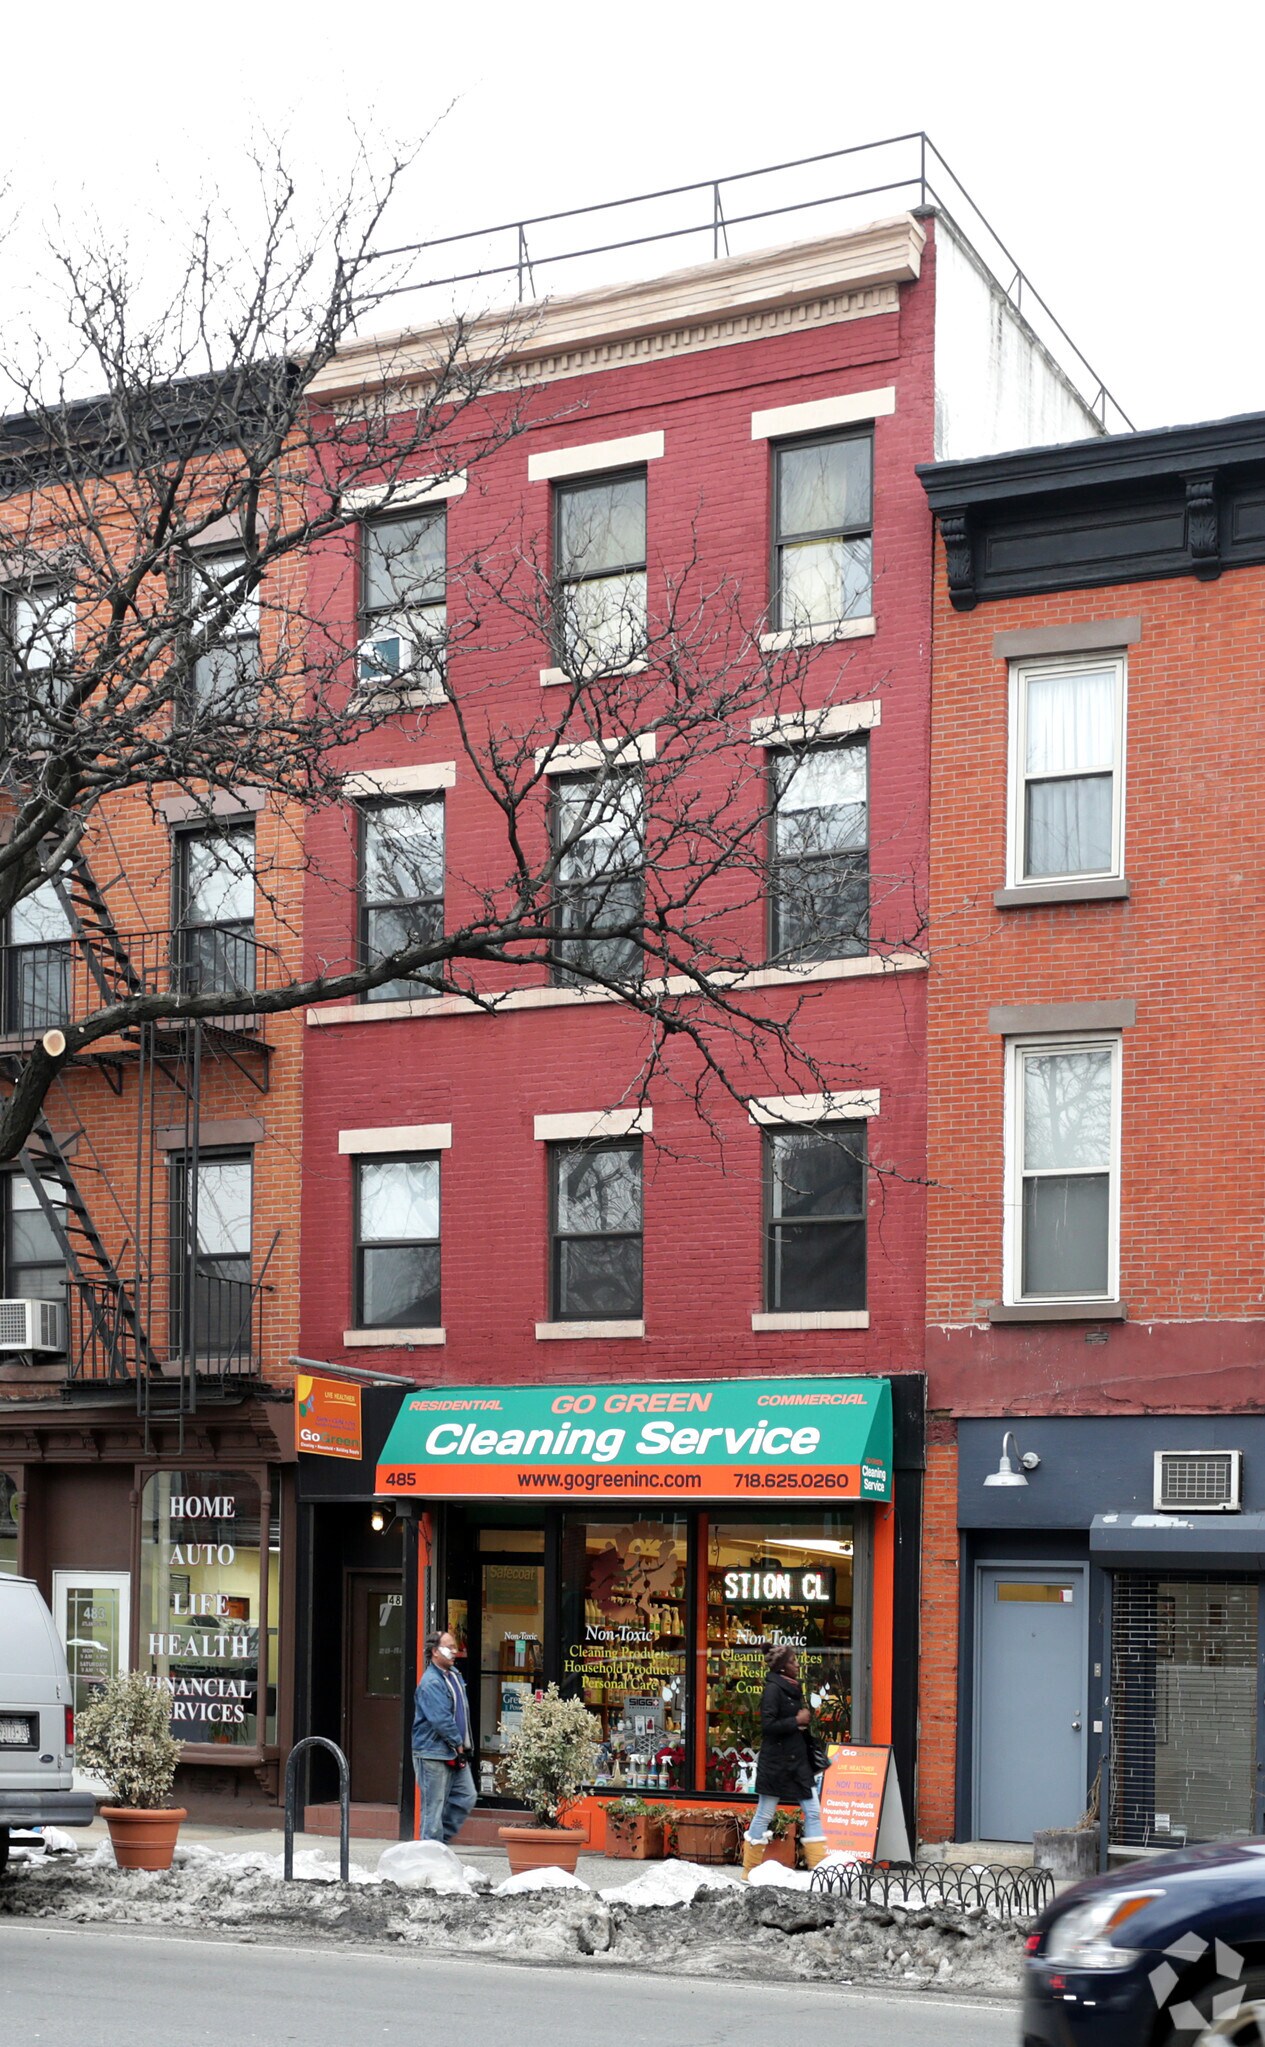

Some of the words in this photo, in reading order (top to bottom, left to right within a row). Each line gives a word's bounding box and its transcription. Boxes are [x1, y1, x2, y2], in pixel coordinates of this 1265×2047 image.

[324, 1391, 333, 1399] LIVE
[757, 1393, 868, 1406] COMMERCIAL
[409, 1400, 503, 1411] RESIDENTIAL
[551, 1394, 597, 1414] GO
[603, 1392, 713, 1414] GREEN
[425, 1421, 626, 1462] Cleaning
[635, 1419, 821, 1455] Service
[386, 1472, 416, 1486] 485
[517, 1471, 701, 1490] www.gogreeninc.com
[733, 1473, 849, 1488] 718.625.0260
[862, 1465, 886, 1482] Cleaning
[863, 1478, 885, 1492] Service
[169, 1496, 235, 1518] HOME
[169, 1543, 235, 1566] AUTO
[724, 1572, 791, 1600] STION
[802, 1573, 830, 1600] CL
[173, 1593, 230, 1616] LIFE
[83, 1607, 105, 1620] 483
[504, 1631, 538, 1640] Non-Toxic
[585, 1625, 653, 1642] Non-Toxic
[736, 1629, 807, 1647] Non-Toxic
[148, 1633, 250, 1658] HEALTH
[569, 1645, 618, 1660] Cleaning
[621, 1646, 670, 1660] Products
[721, 1649, 765, 1662] Cleanin
[564, 1660, 623, 1674] Household
[626, 1662, 675, 1675] Products
[582, 1676, 627, 1689] Personal
[630, 1678, 658, 1690] Care
[628, 1698, 653, 1706] SIGG
[168, 1701, 245, 1723] RVICES
[836, 1781, 850, 1789] NON
[854, 1782, 872, 1790] TOXIC
[826, 1799, 849, 1808] Cleaning
[851, 1800, 874, 1809] Products
[822, 1808, 851, 1816] Household
[852, 1809, 875, 1818] Products
[827, 1816, 849, 1826] Building
[850, 1817, 869, 1827] Supply
